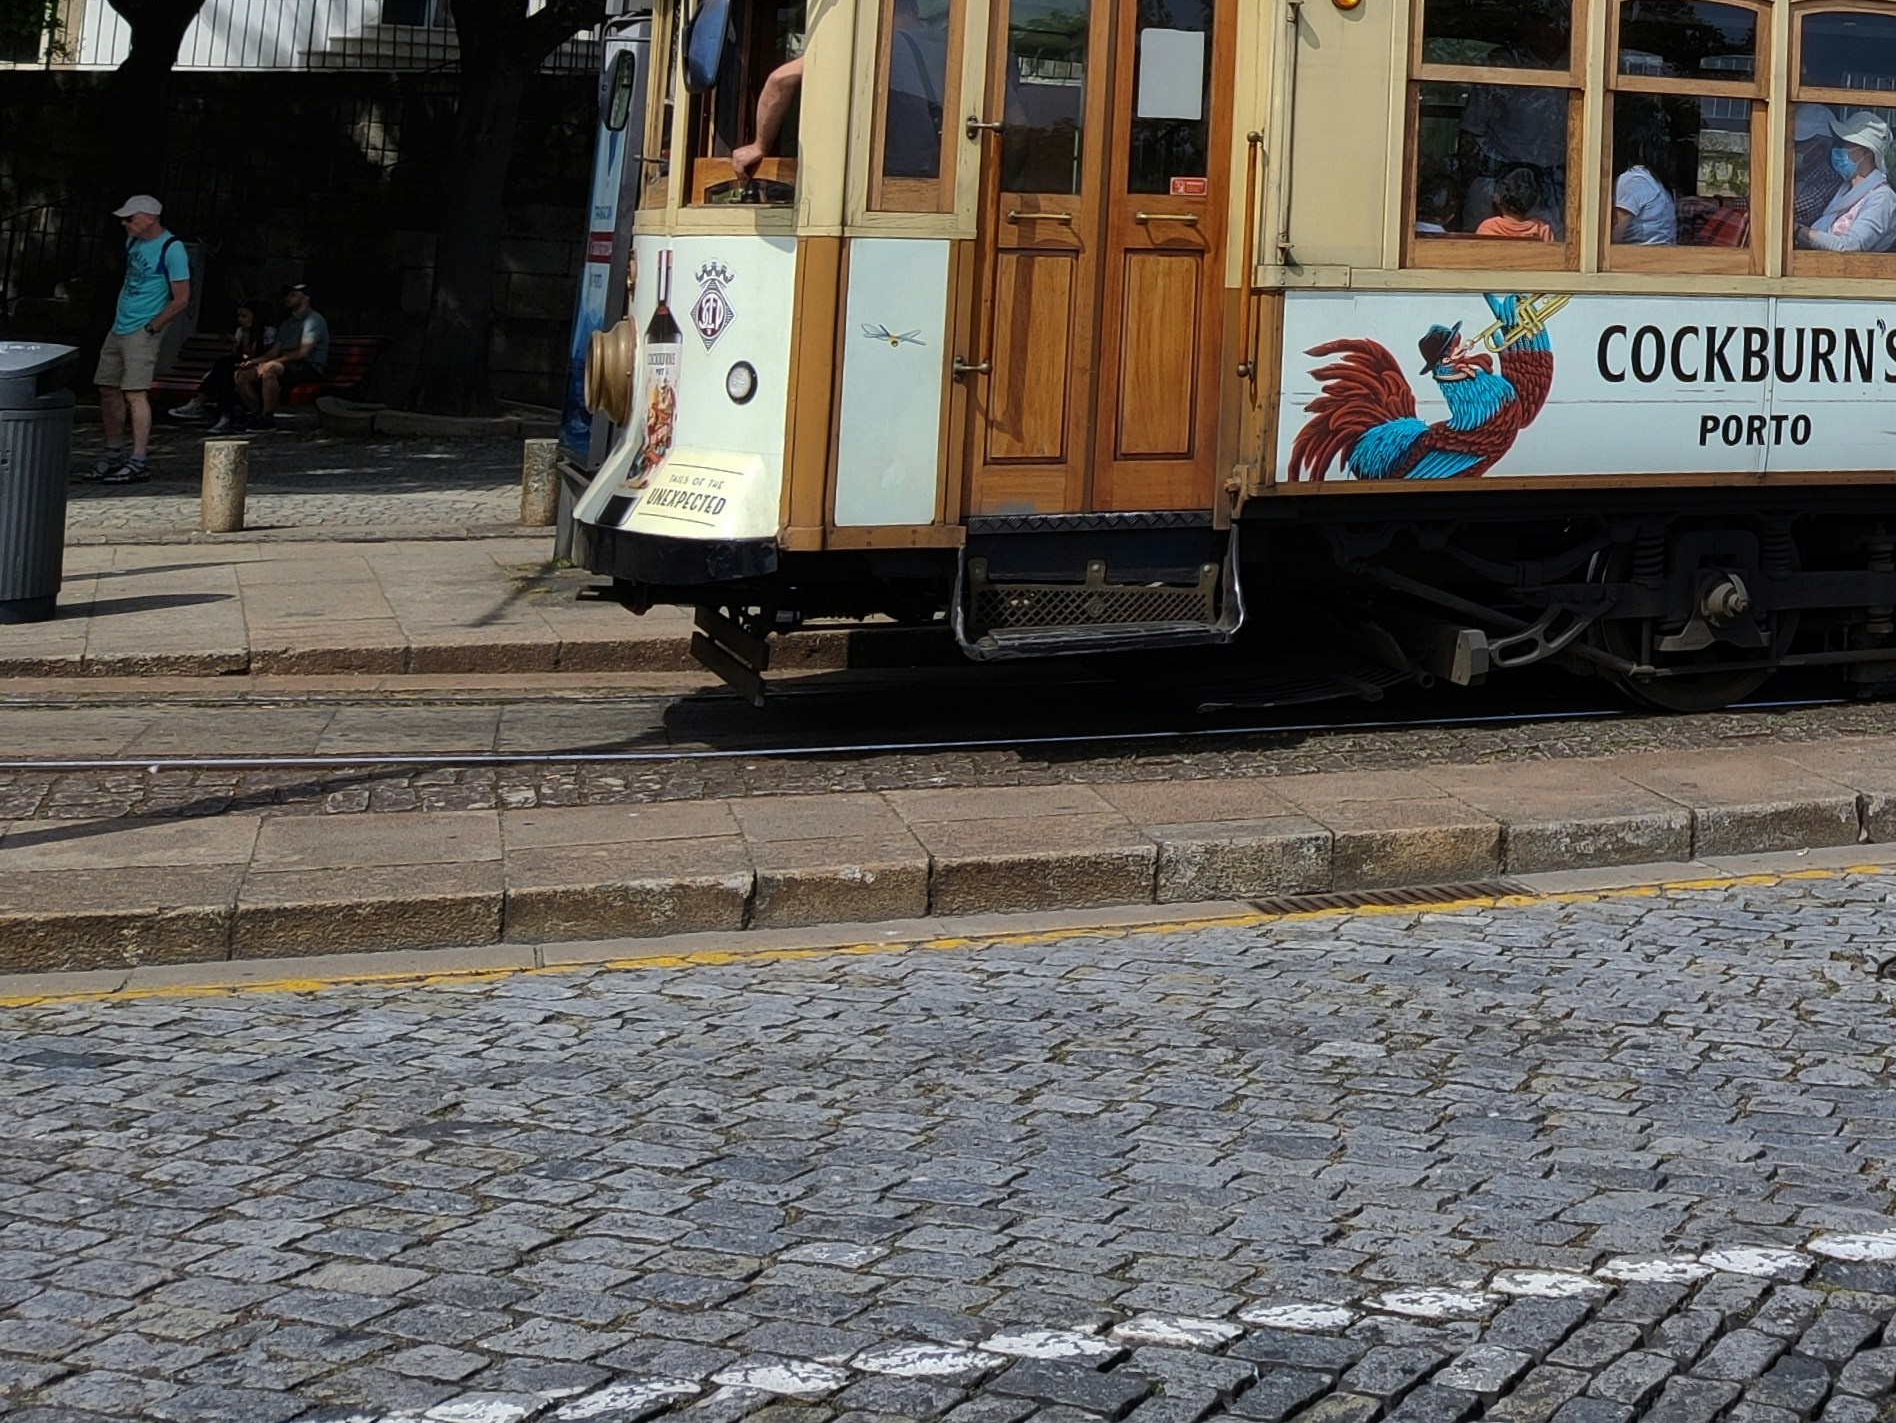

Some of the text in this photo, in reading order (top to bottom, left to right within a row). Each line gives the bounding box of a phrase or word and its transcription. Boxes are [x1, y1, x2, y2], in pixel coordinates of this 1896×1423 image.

[1698, 414, 1812, 447] PORTO
[668, 473, 725, 490] TAILS OF THE
[646, 487, 727, 516] UNEXPECTED
